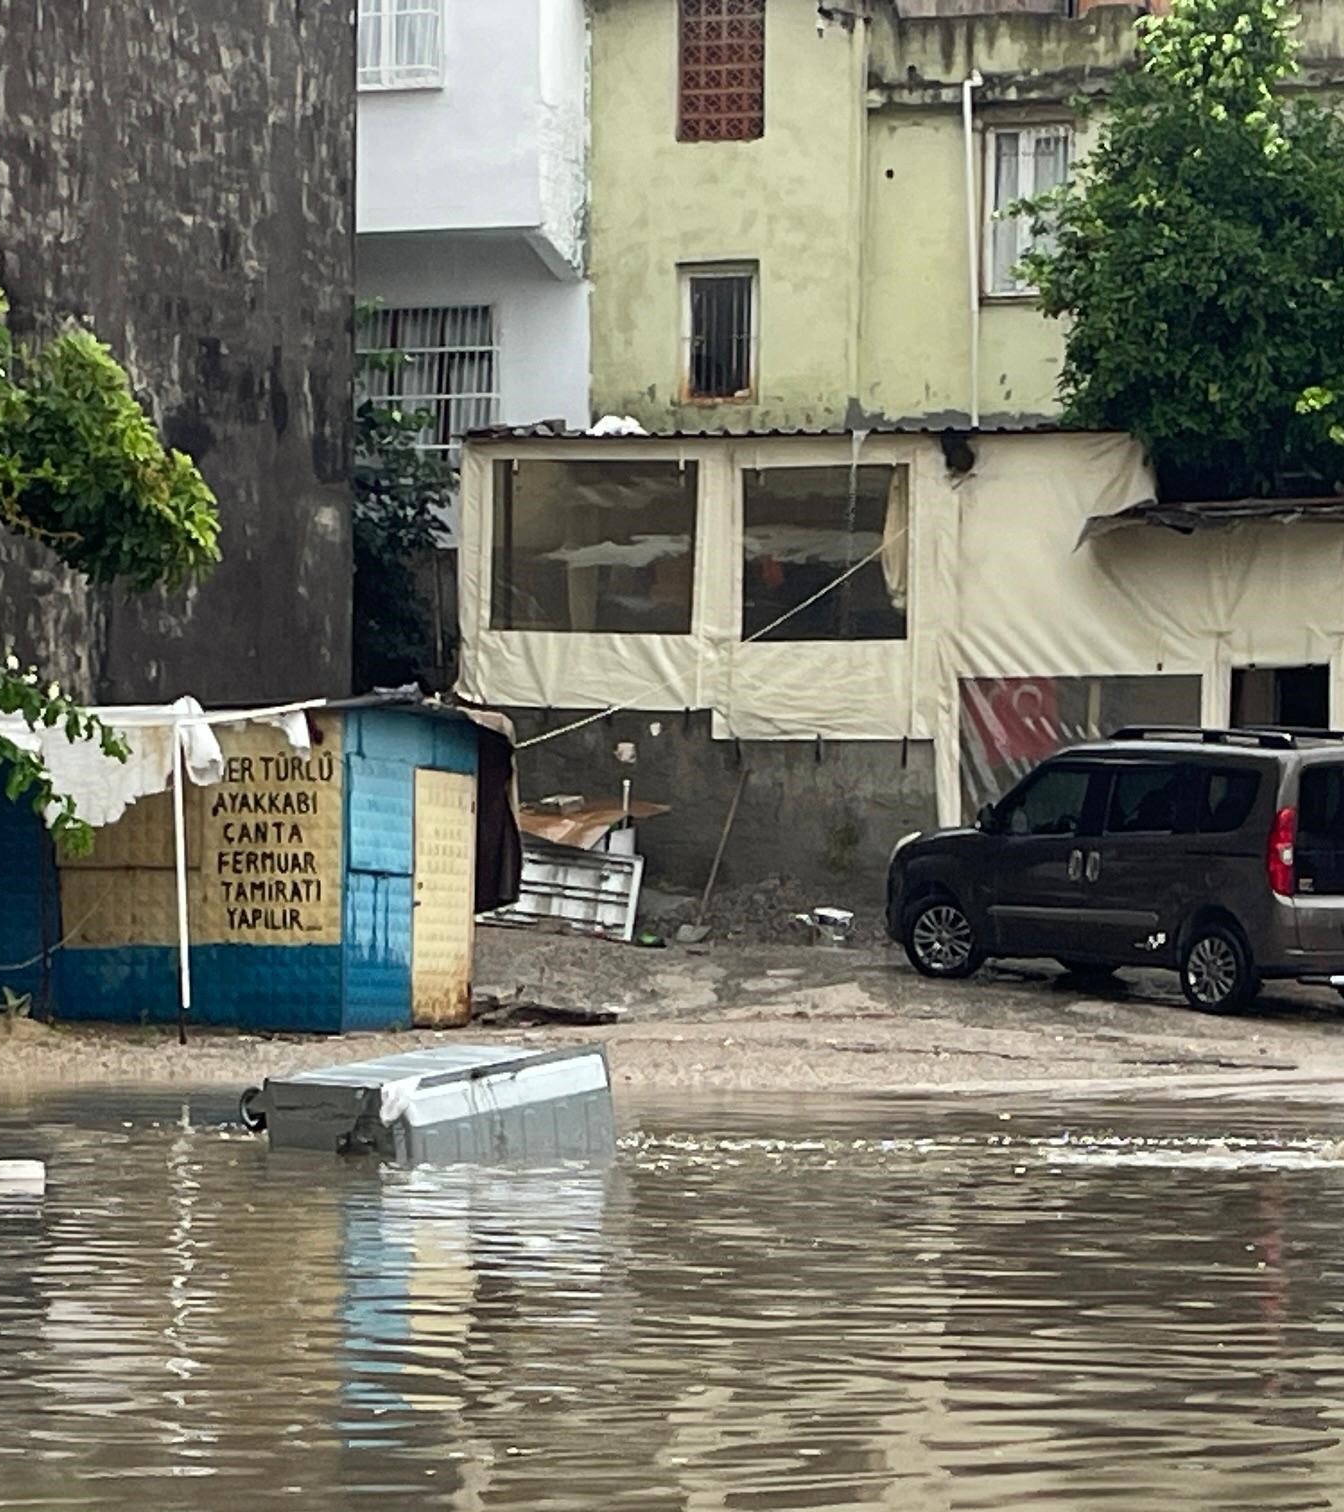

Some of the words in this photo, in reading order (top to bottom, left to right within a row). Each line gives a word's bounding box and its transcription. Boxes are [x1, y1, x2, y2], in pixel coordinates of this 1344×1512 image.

[259, 751, 334, 782] TÜRLÜ
[213, 791, 318, 816] AYAKKABI
[223, 821, 303, 844] ÇANTA
[218, 851, 317, 874] FERMUAR
[221, 879, 321, 903] TAMİRATI
